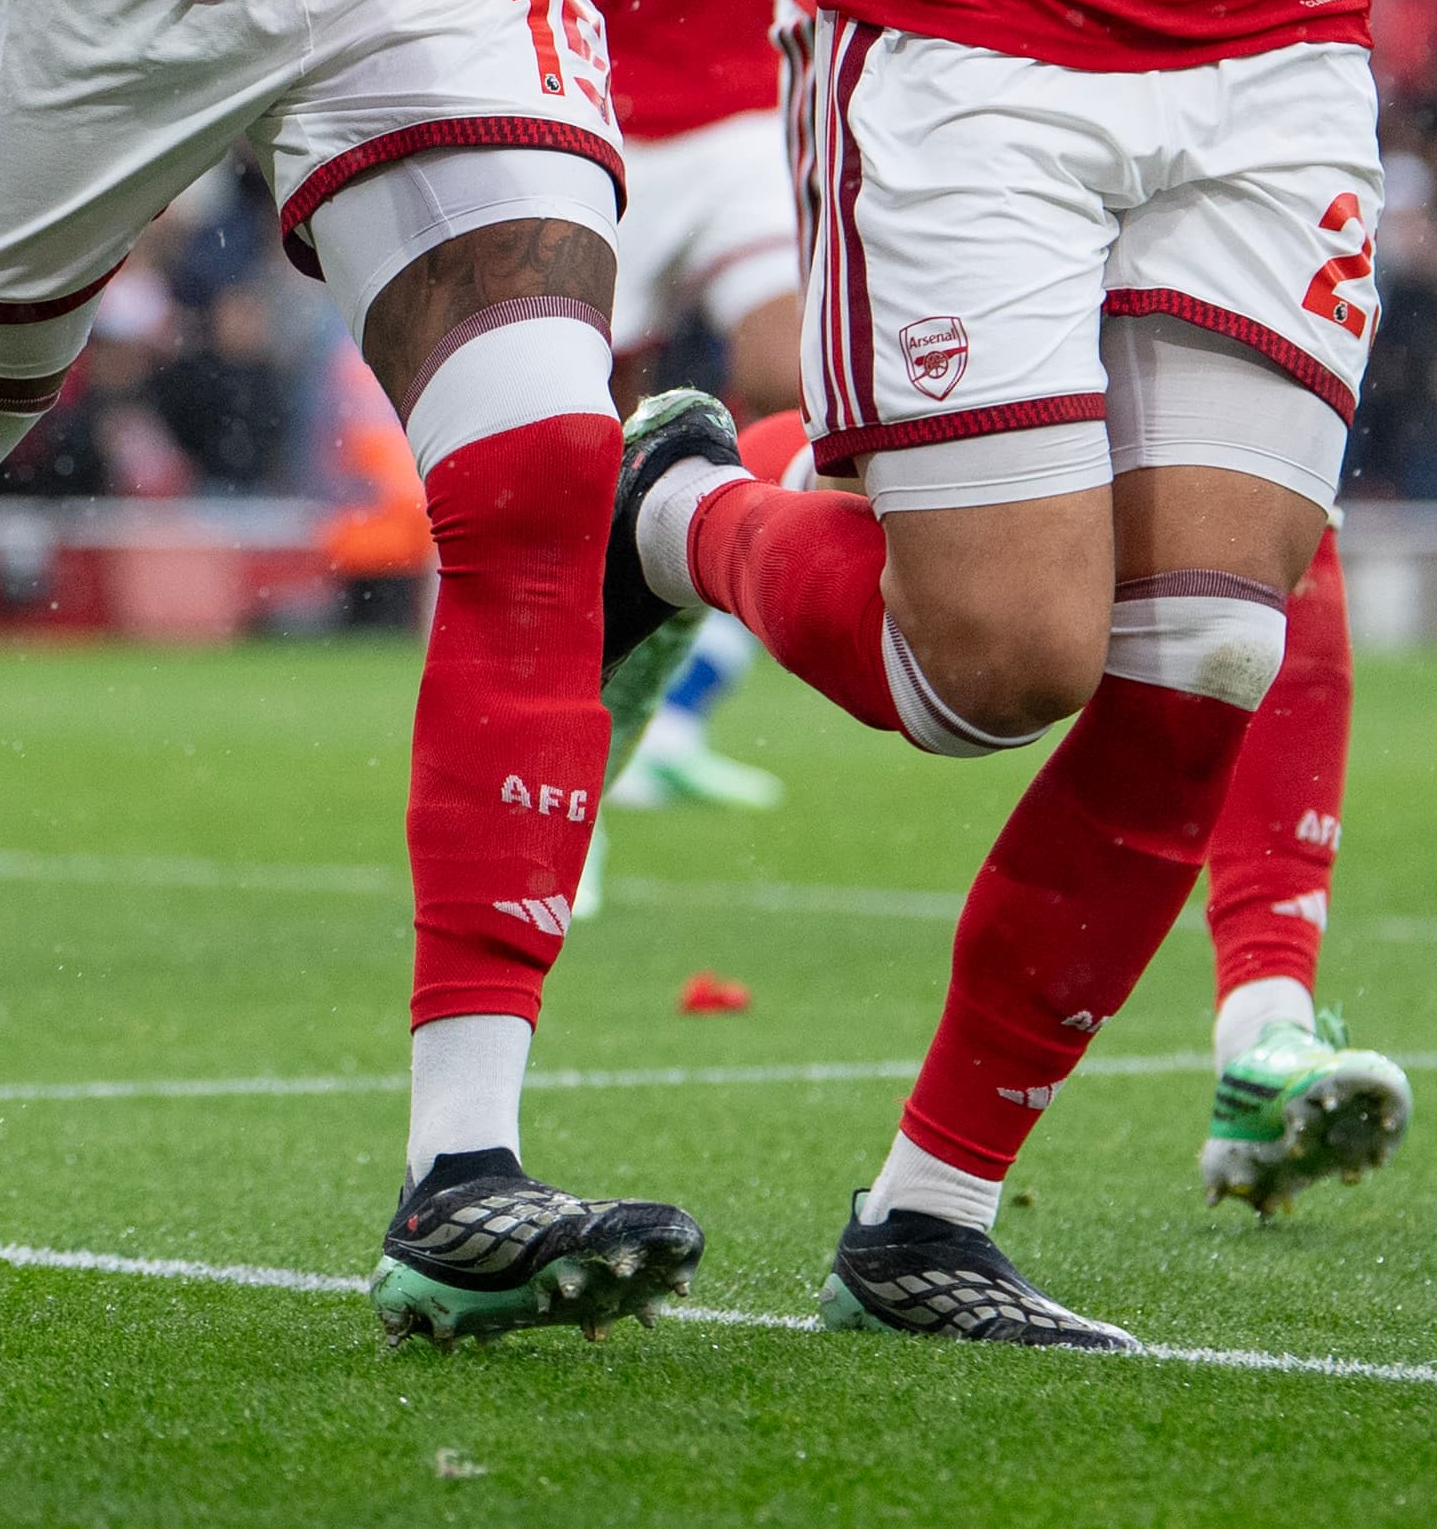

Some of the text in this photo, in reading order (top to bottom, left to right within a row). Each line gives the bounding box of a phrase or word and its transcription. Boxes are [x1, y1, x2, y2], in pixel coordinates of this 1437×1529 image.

[1301, 192, 1379, 352] 2
[909, 328, 957, 350] Arsenal
[501, 774, 588, 822] AFC
